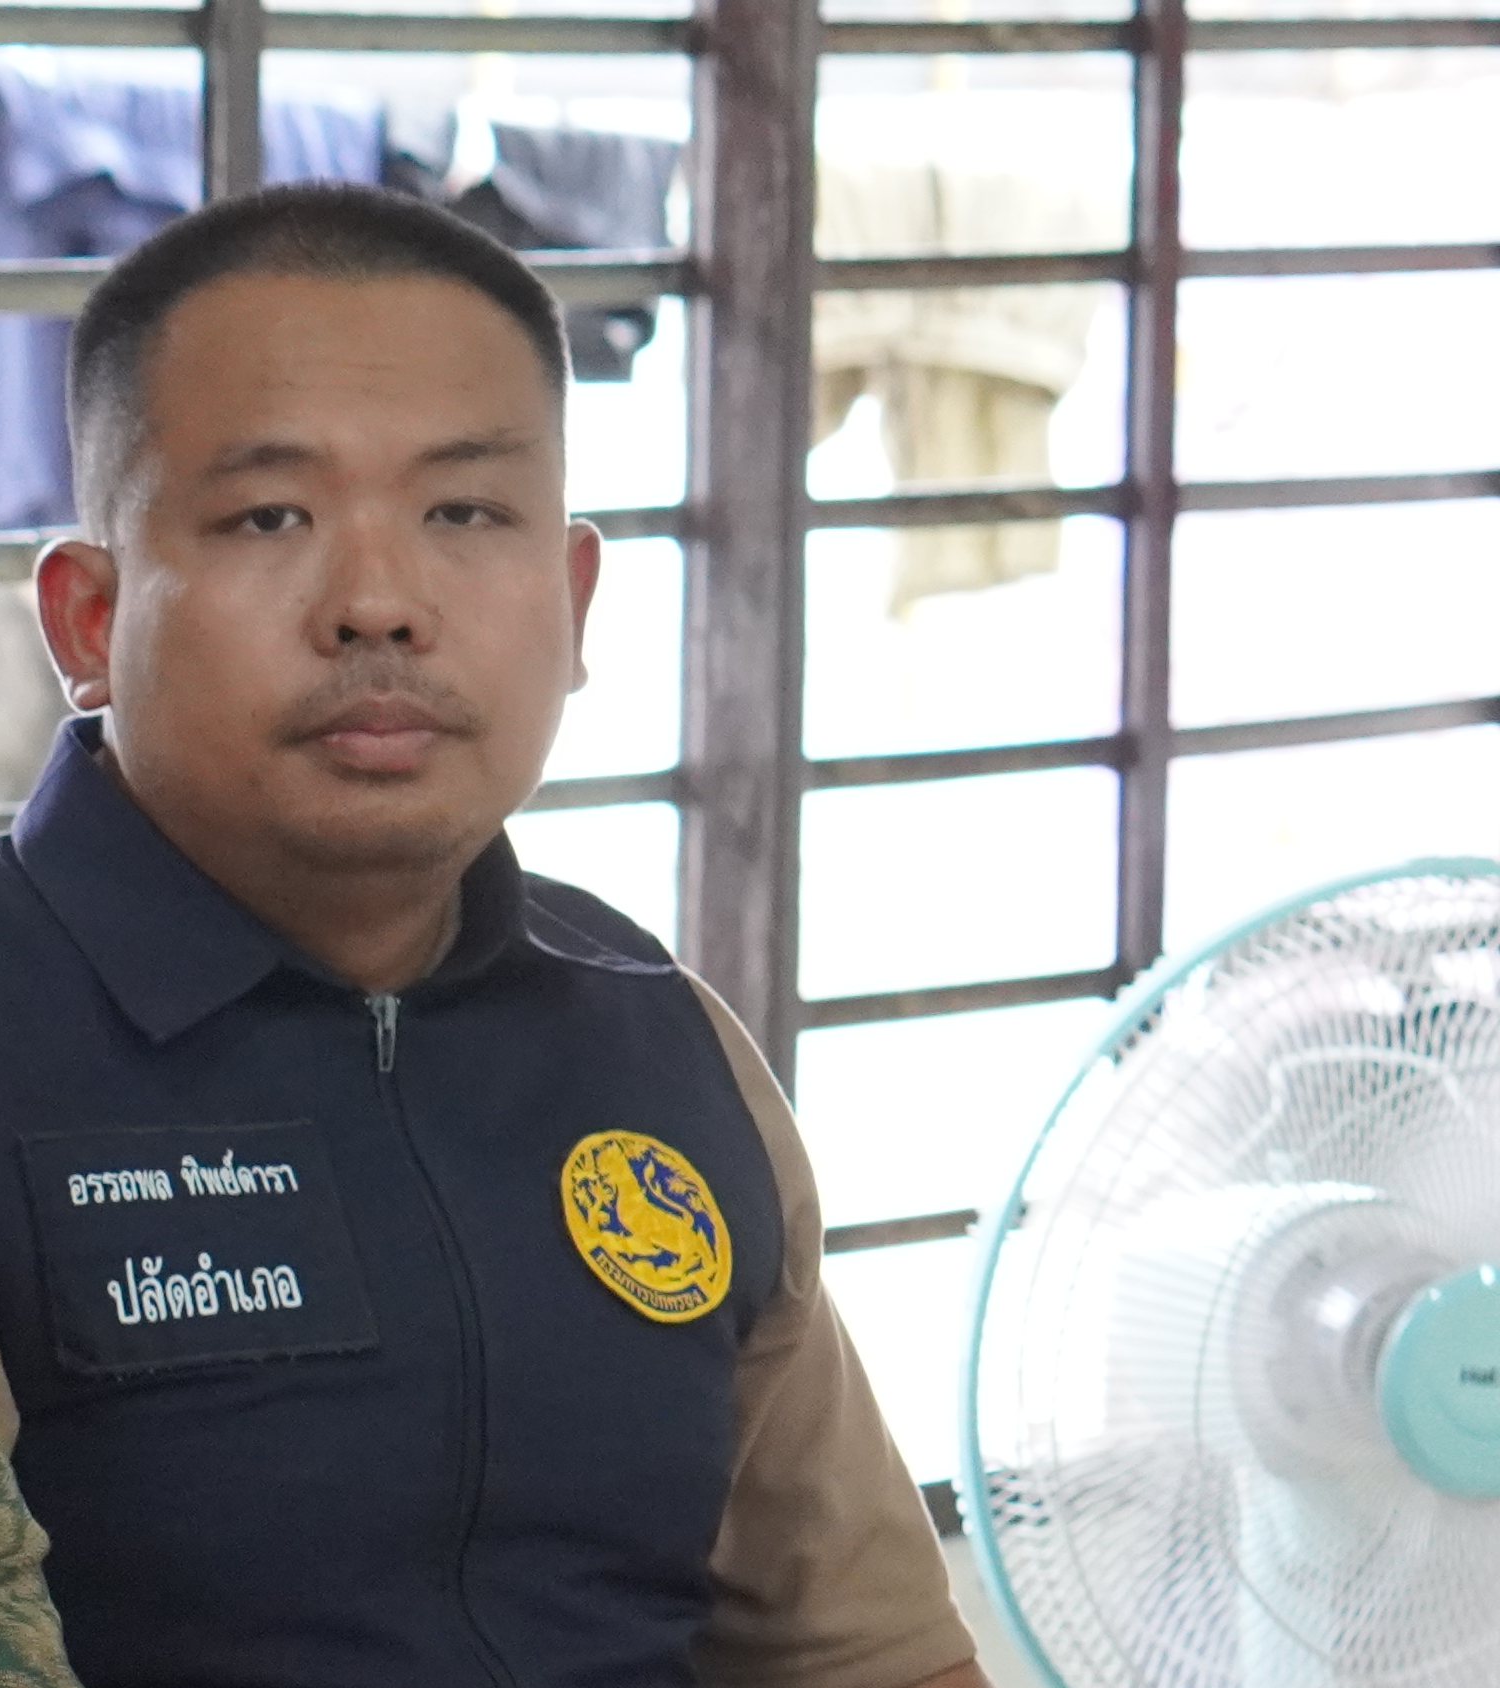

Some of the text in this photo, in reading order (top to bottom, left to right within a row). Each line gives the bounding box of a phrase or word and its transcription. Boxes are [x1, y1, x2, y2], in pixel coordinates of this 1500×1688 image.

[68, 1148, 299, 1206] อรรถพล ทิพย์ดารา
[107, 1252, 302, 1325] ปลัดอำเภอ
